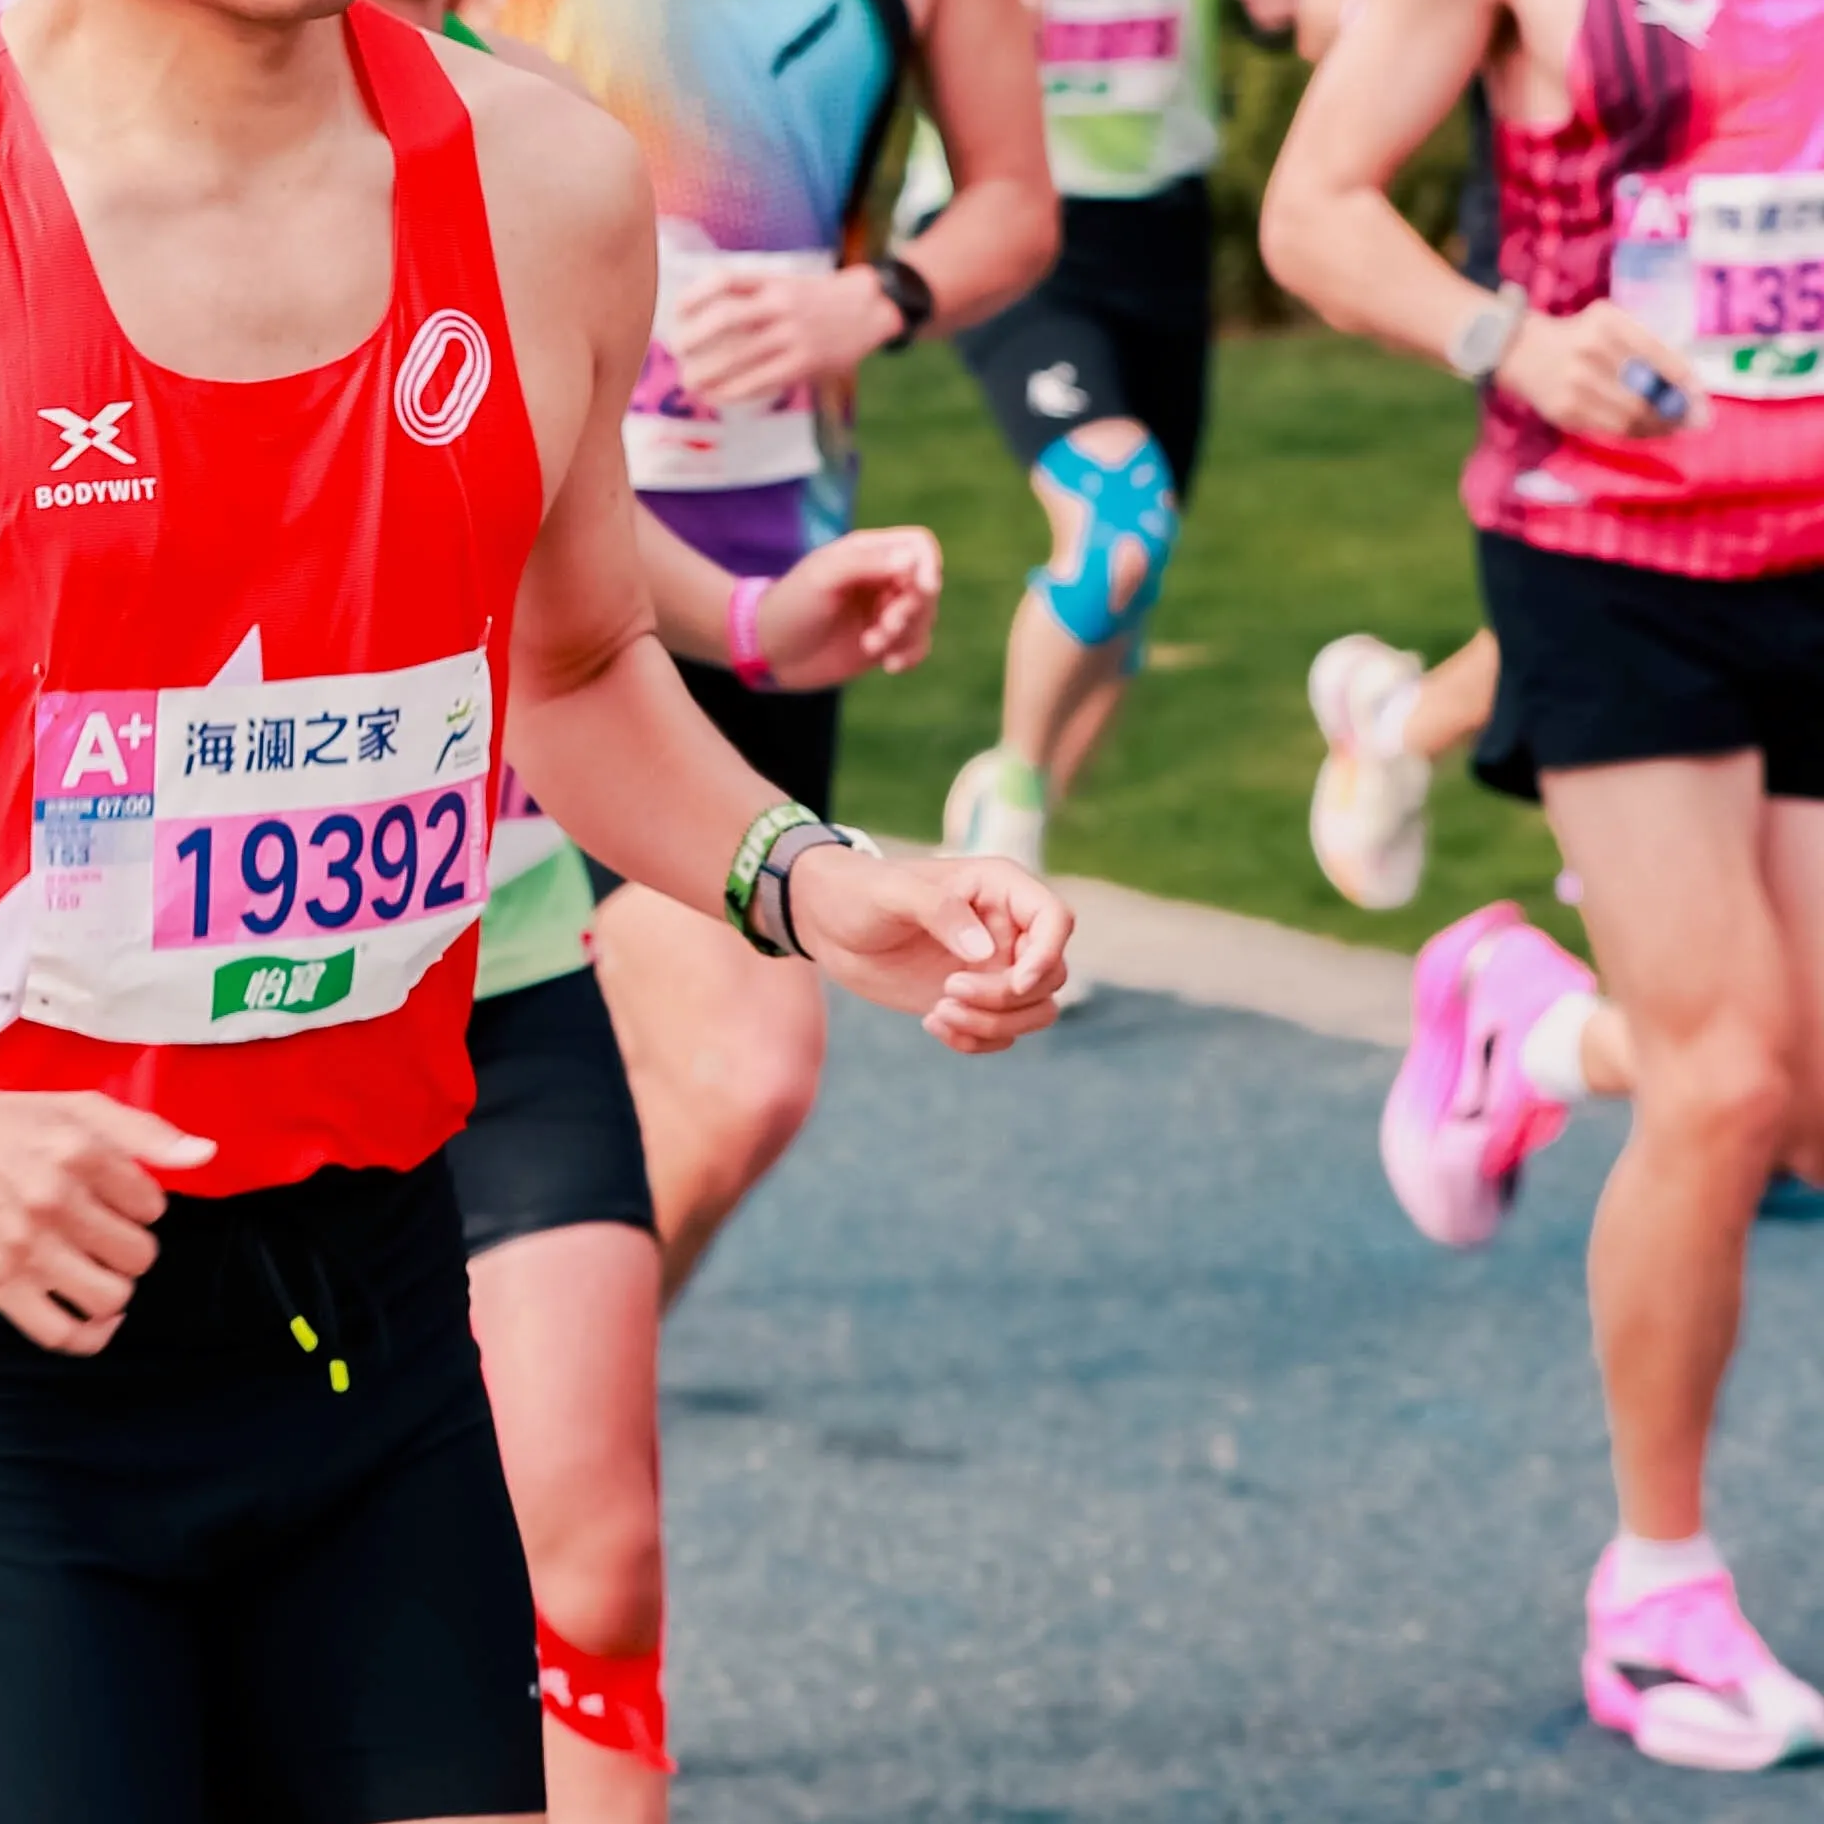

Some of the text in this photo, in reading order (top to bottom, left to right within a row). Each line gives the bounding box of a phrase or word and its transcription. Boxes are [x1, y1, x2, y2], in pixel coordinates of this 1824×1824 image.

[34, 476, 157, 510] BODYWIT
[61, 711, 153, 789] A+
[184, 706, 401, 776] 海澜之家
[175, 790, 467, 939] 19392
